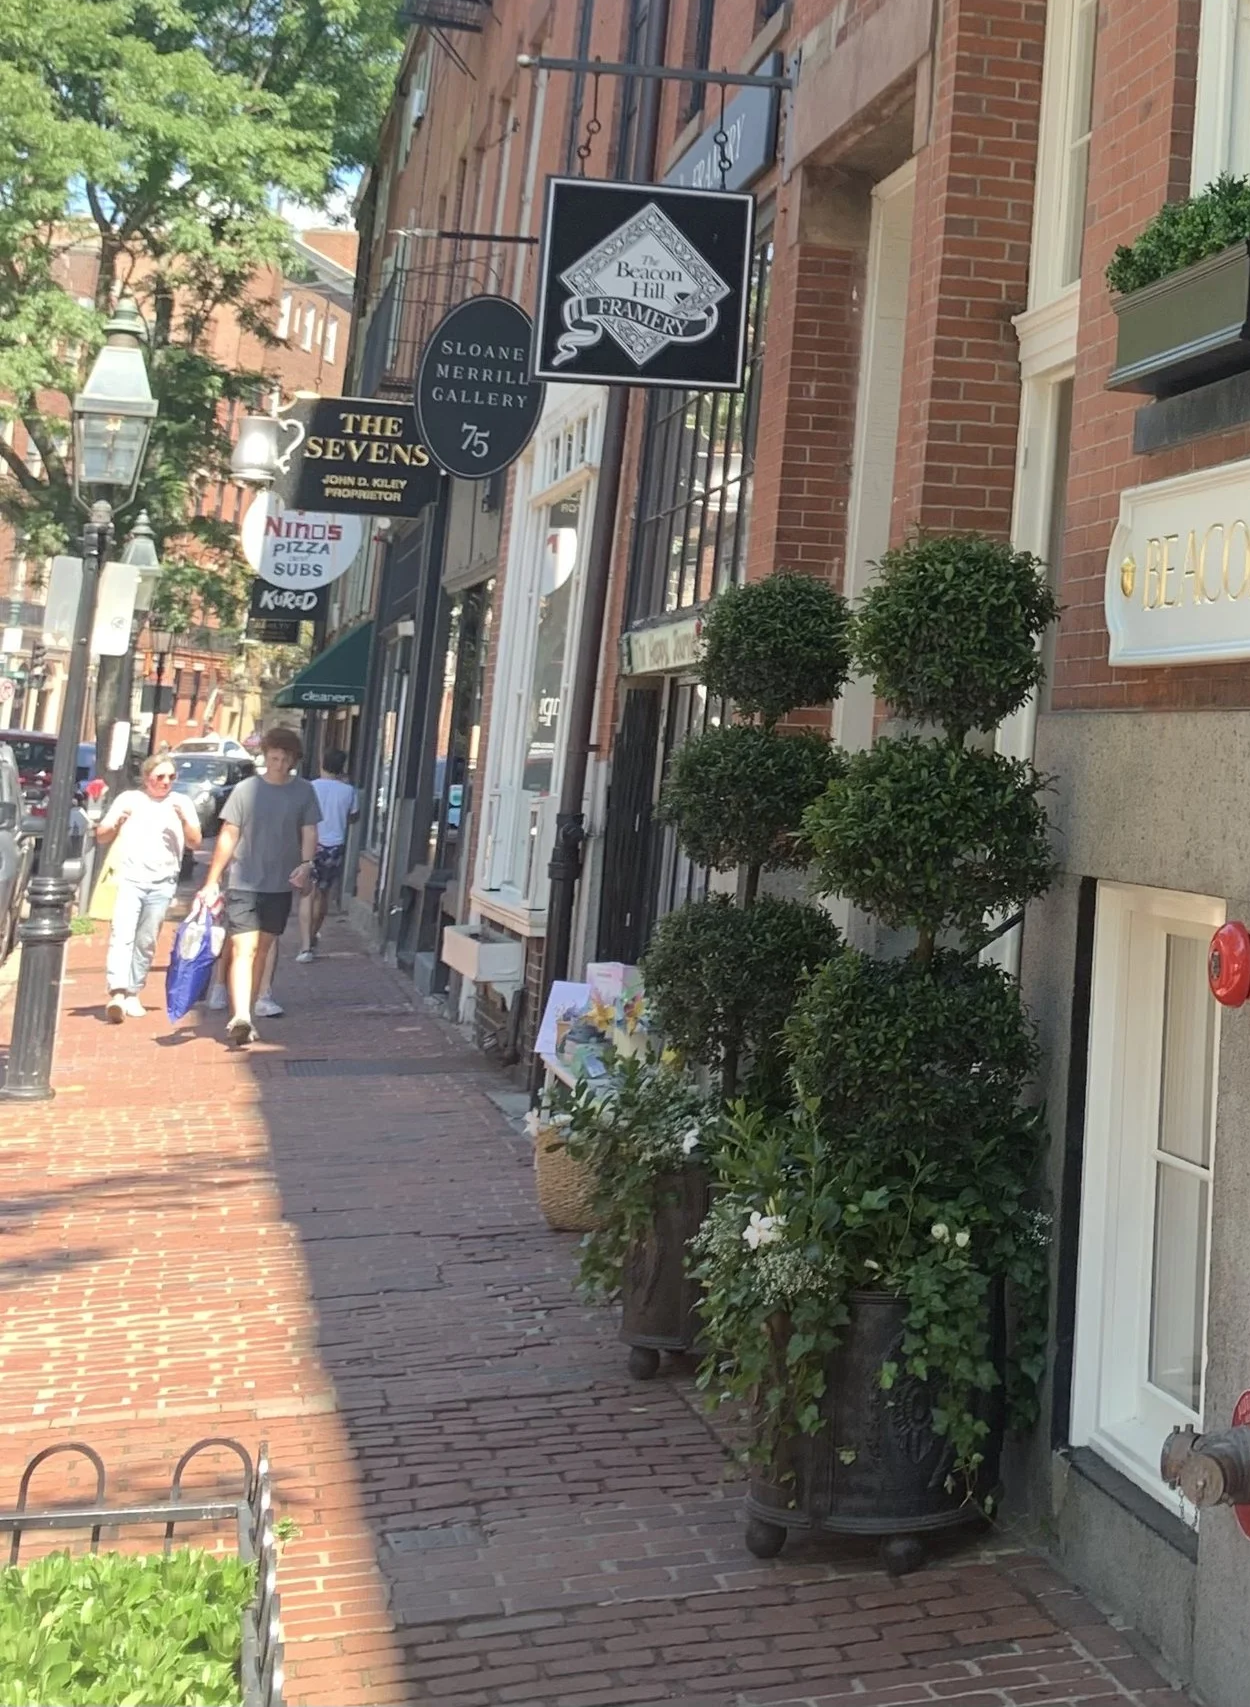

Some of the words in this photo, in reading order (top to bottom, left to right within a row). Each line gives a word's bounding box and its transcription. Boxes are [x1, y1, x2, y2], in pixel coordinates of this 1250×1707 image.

[616, 261, 683, 282] Beacon
[633, 281, 665, 300] Hill
[599, 298, 689, 336] FRAMERY
[441, 340, 526, 362] SLOANE
[436, 363, 530, 385] MERRILL
[431, 386, 529, 409] GALLERY
[339, 412, 404, 438] THE
[461, 422, 490, 458] 75
[304, 435, 430, 467] SEVENS
[321, 474, 355, 486] JOHN
[357, 477, 369, 487] D.
[372, 478, 408, 490] KILEY
[324, 487, 402, 503] PROPRIETOR
[272, 540, 330, 557] PIZZA
[273, 562, 323, 577] SUBS
[301, 690, 355, 703] cleaners
